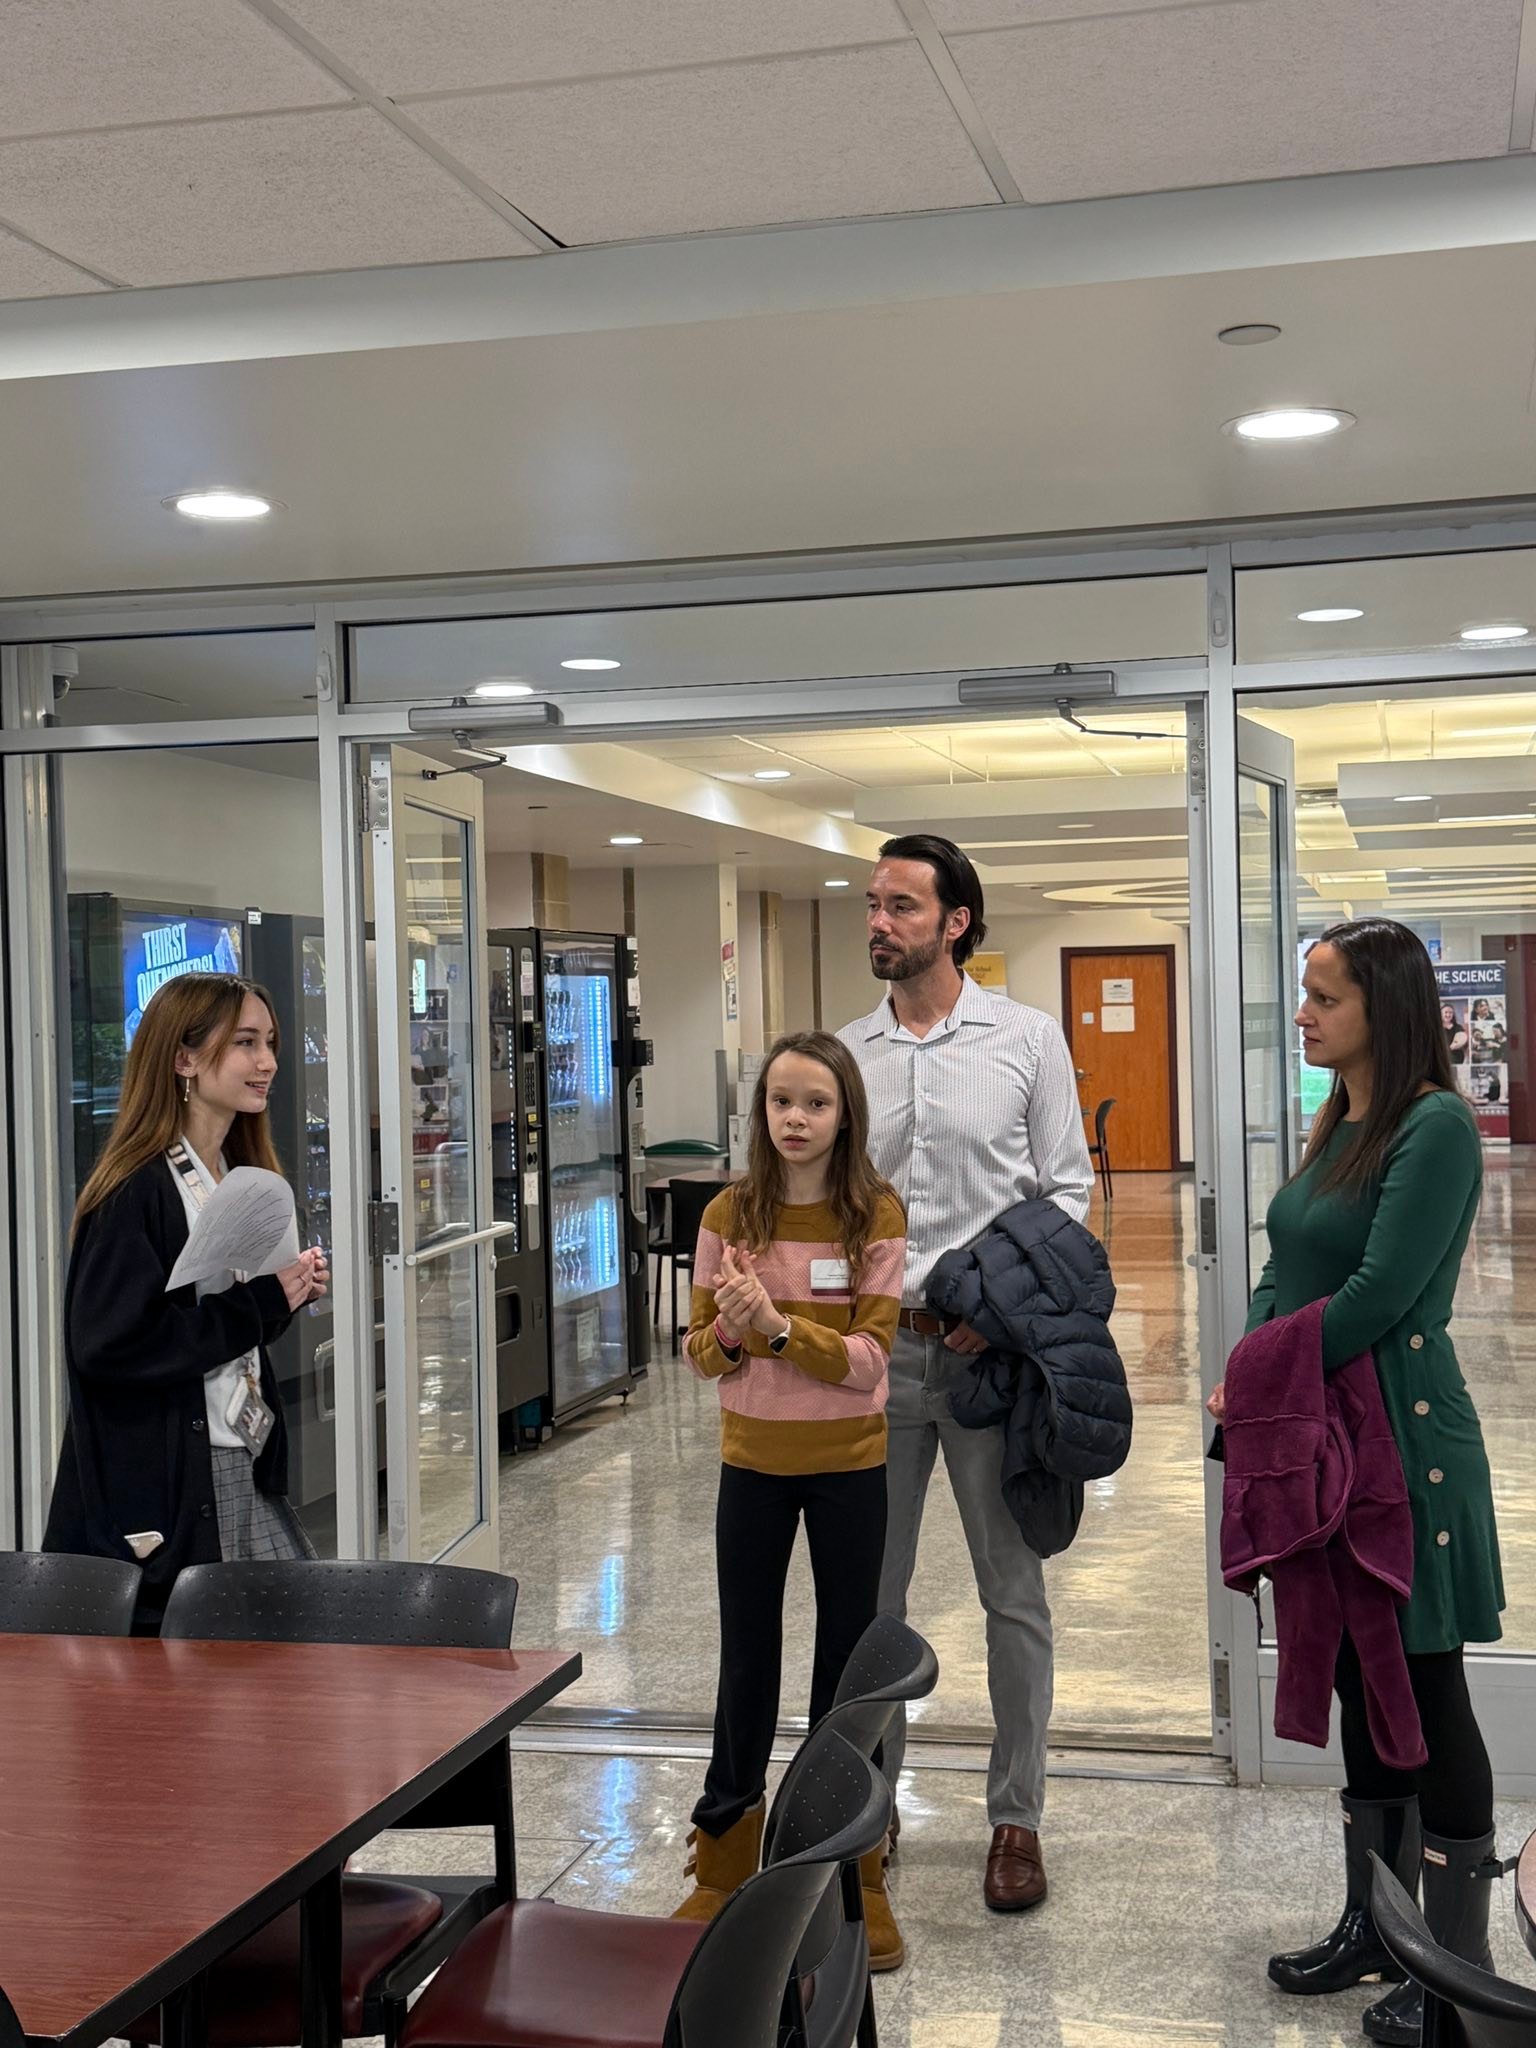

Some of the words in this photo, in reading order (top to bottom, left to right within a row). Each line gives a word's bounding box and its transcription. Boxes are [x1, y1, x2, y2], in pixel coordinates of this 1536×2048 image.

[142, 923, 187, 969] THIRST
[1435, 971, 1451, 984] HE
[1451, 969, 1502, 984] SCIENCE
